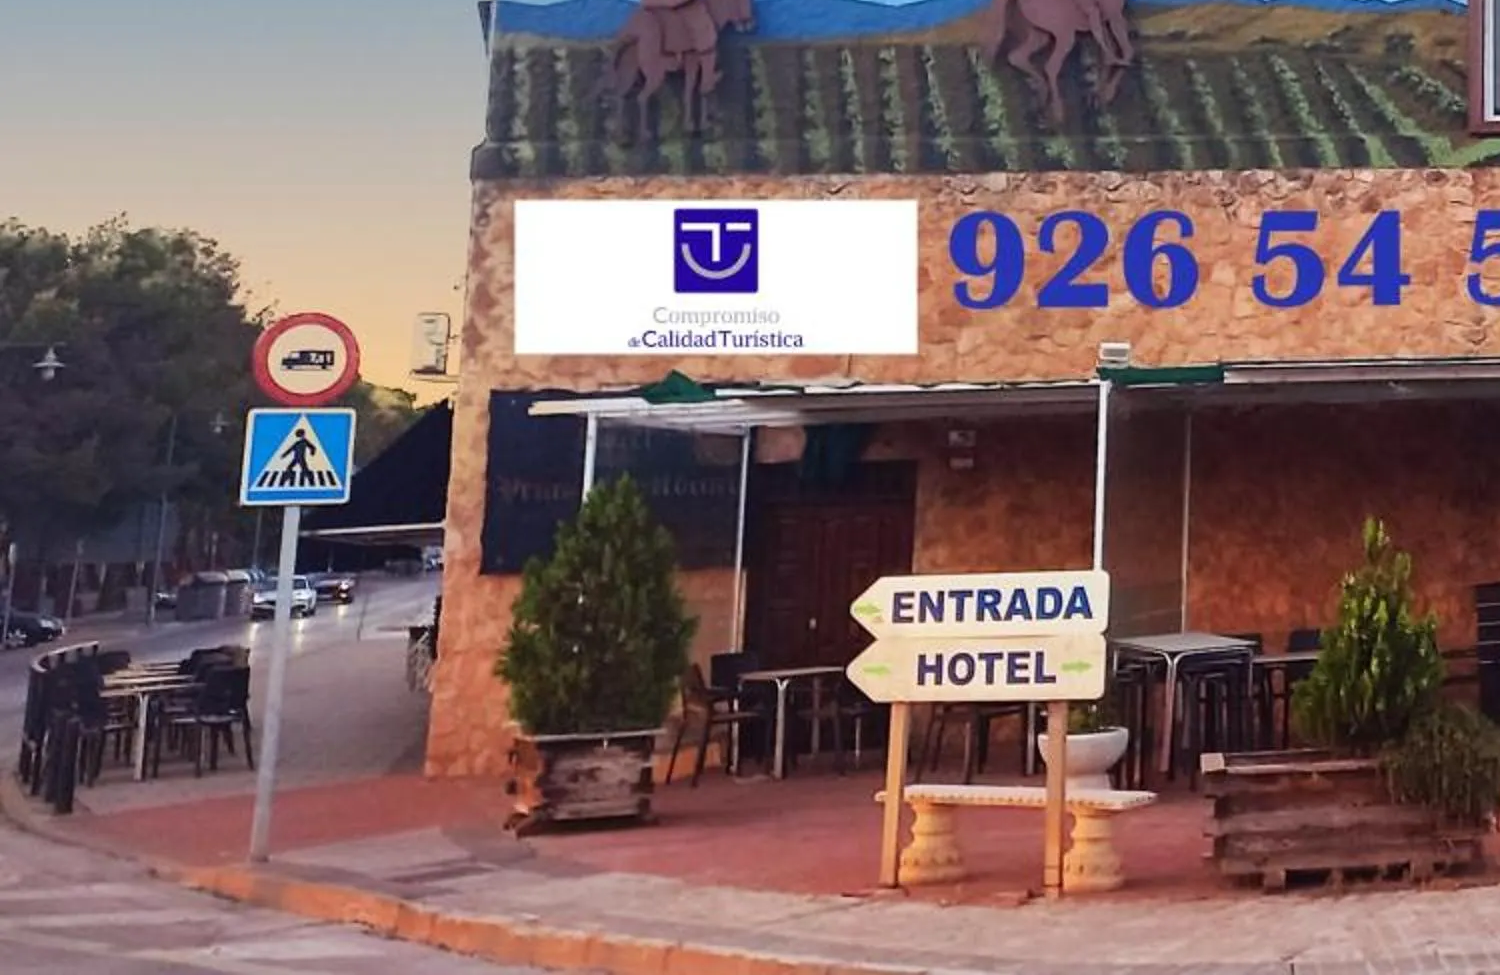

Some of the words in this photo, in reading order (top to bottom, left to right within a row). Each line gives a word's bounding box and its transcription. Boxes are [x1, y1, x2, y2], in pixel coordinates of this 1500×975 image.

[948, 209, 1199, 310] 926
[1251, 209, 1411, 306] 54
[652, 306, 781, 326] Compromiso
[641, 329, 716, 348] Calidad
[718, 329, 804, 348] Turística
[891, 586, 1093, 624] ENTRADA
[916, 651, 1057, 686] HOTEL
